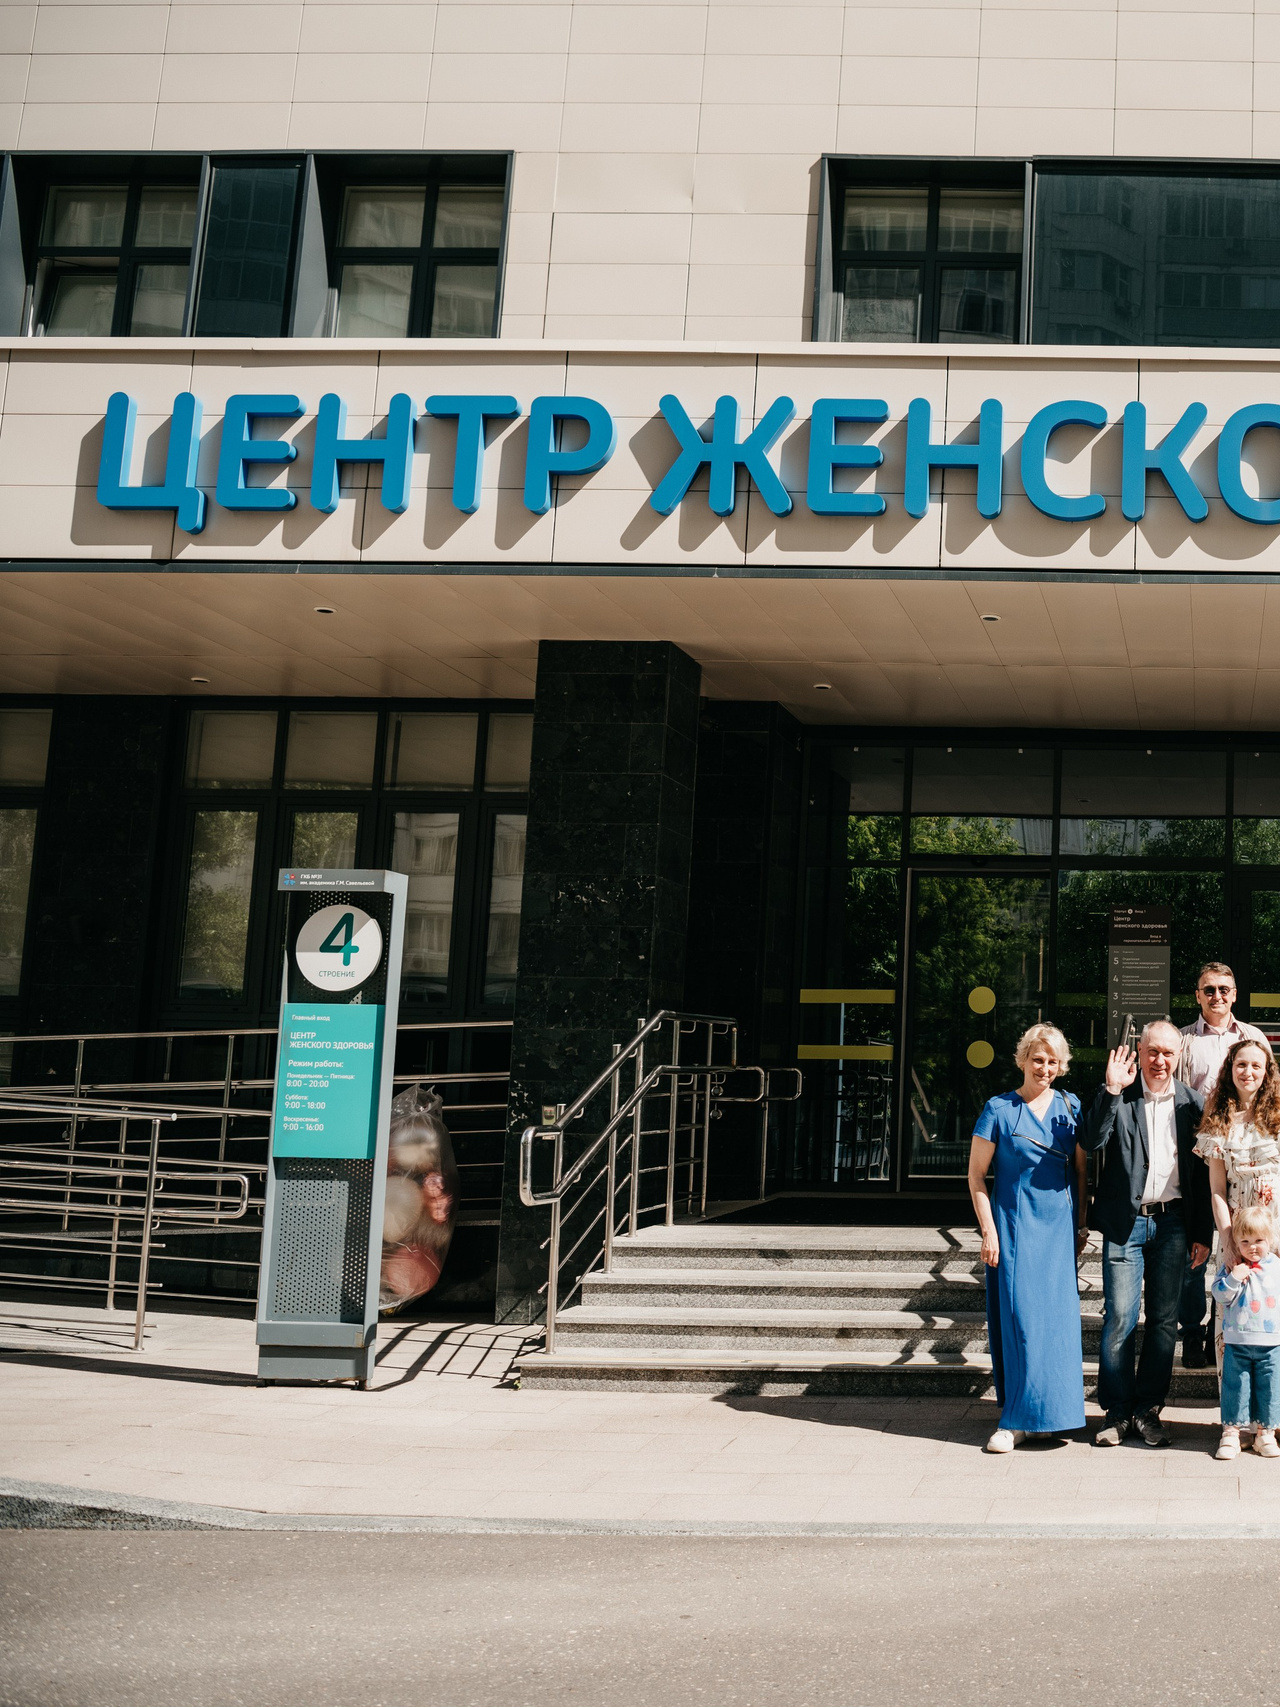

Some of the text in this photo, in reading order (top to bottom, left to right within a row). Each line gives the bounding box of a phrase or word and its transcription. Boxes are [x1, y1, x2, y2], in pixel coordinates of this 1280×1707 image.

[97, 391, 617, 535] ЦЕНТР
[319, 912, 359, 966] 4
[1113, 957, 1119, 965] 5
[318, 970, 356, 978] СТРОЕНИЕ
[1113, 992, 1119, 1000] 3
[1112, 1009, 1118, 1018] 2
[290, 1031, 316, 1040] ЦЕНТР
[289, 1041, 374, 1050] ЖЕНСКОГО ЗДОРОВЬЯ
[314, 1060, 344, 1068] работы:
[286, 1080, 302, 1088] 8:00
[309, 1080, 329, 1088] 20:00
[283, 1123, 299, 1131] 9:00
[305, 1123, 324, 1131] 16:00
